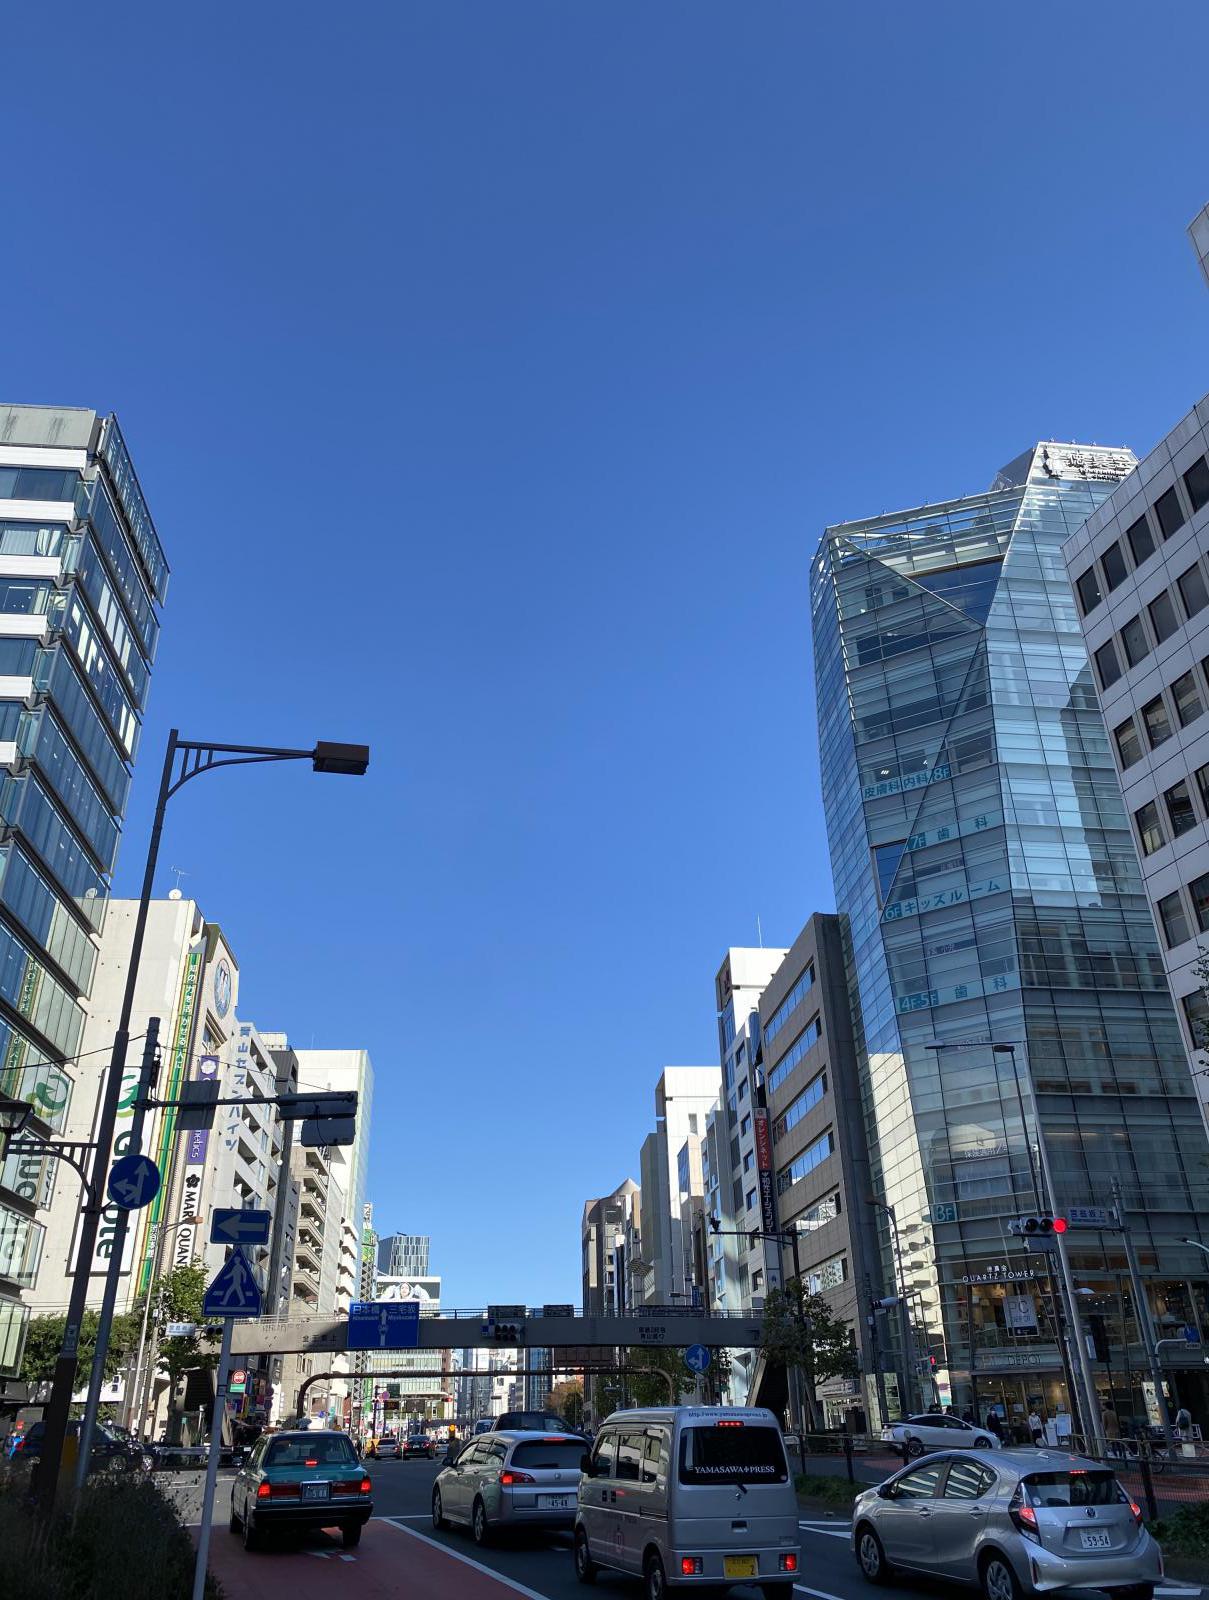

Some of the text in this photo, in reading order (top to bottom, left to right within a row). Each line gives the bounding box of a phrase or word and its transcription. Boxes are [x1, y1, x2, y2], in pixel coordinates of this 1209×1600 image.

[911, 834, 925, 848] 7F
[885, 879, 1001, 920] 6F キッズルーム
[180, 1190, 198, 1223] MAR
[962, 1269, 1035, 1283] QUARTZ TOWER
[694, 1466, 775, 1474] YAMASAWA PRESS
